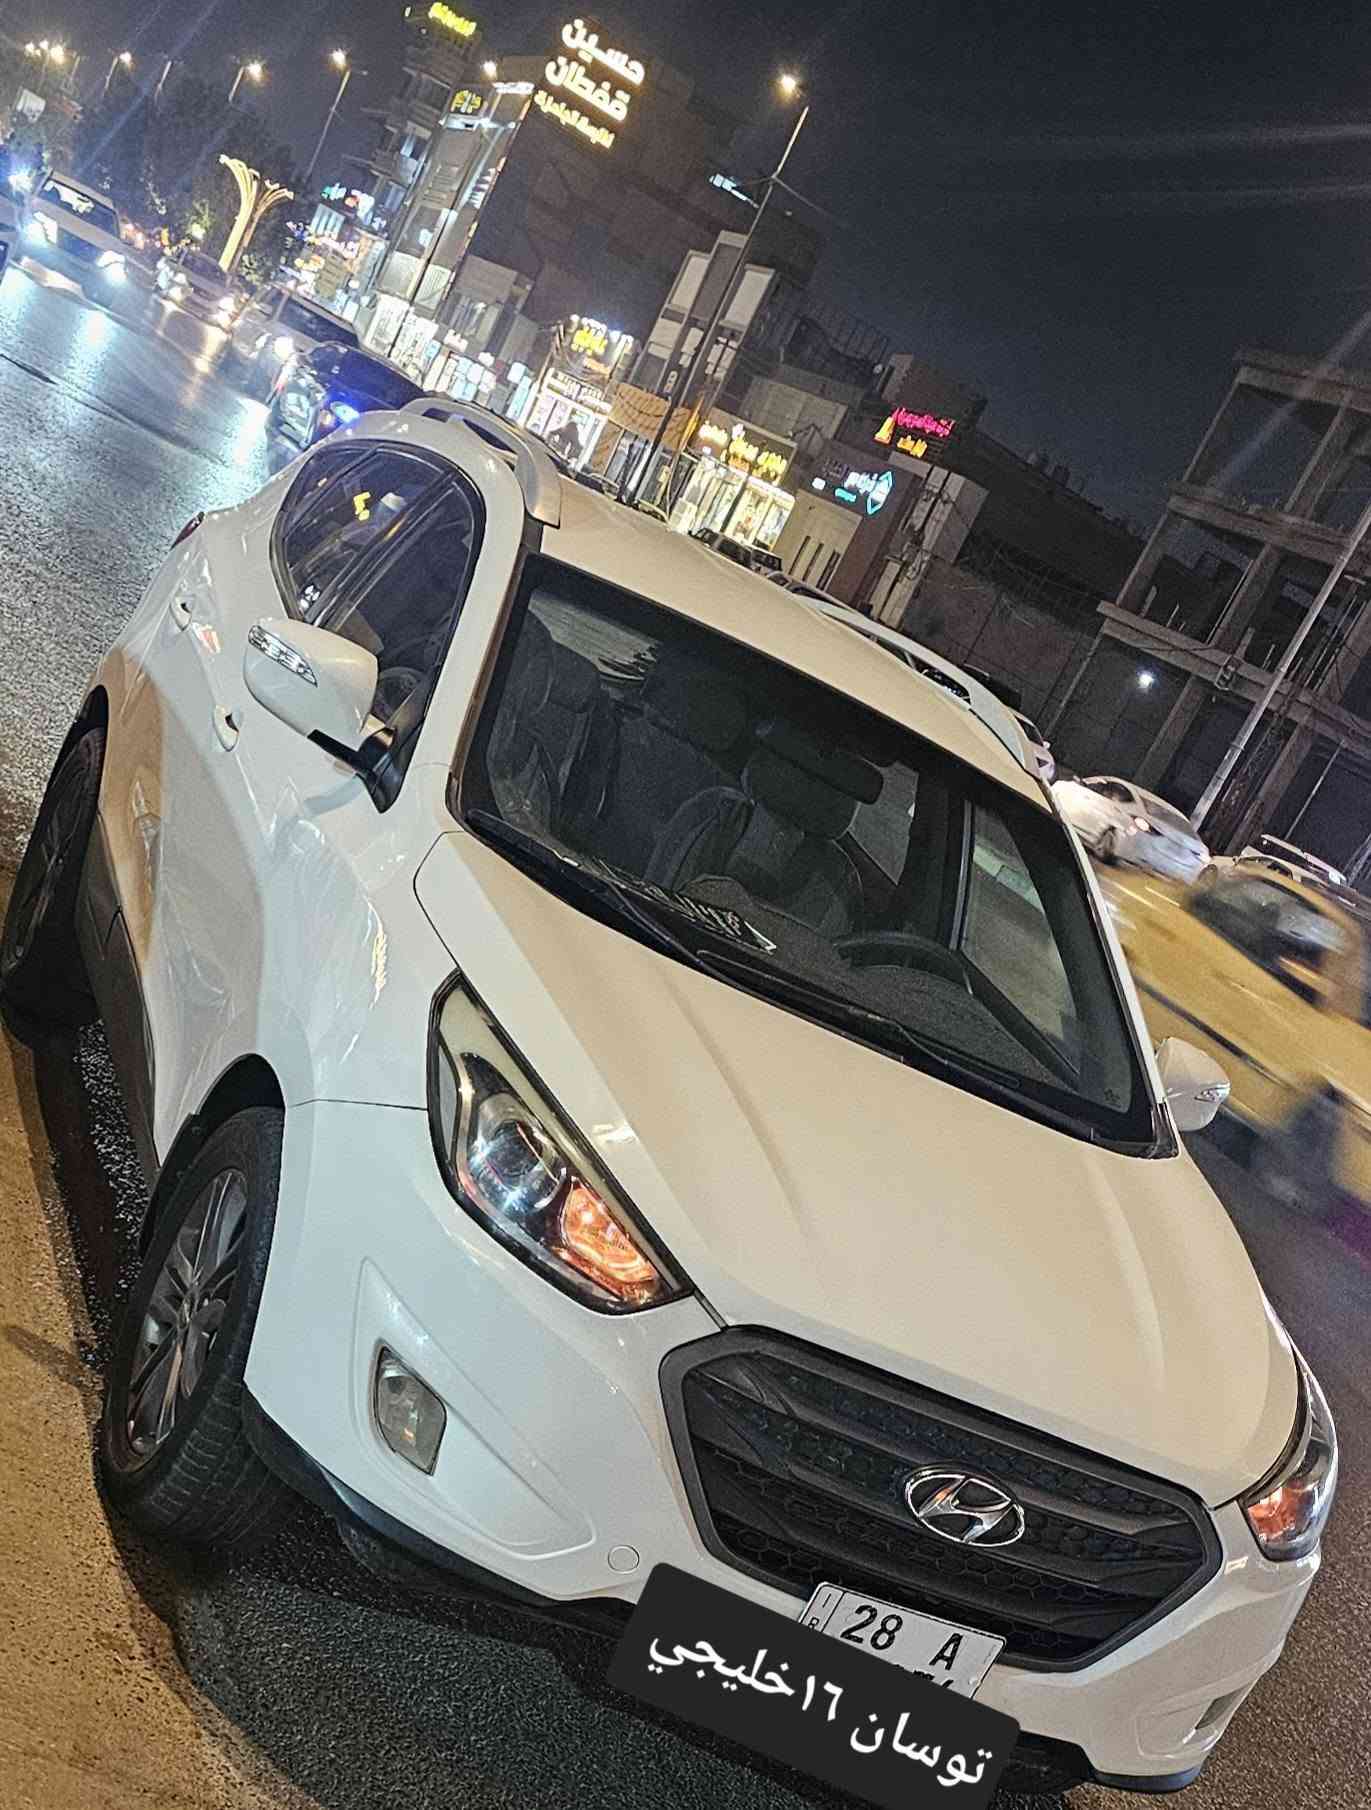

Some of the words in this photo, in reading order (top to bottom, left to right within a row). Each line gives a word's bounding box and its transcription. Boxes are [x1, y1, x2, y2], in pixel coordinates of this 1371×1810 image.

[561, 18, 645, 86] حسين
[544, 55, 631, 122] قفطان
[840, 1604, 903, 1651] 28
[929, 1633, 964, 1671] A
